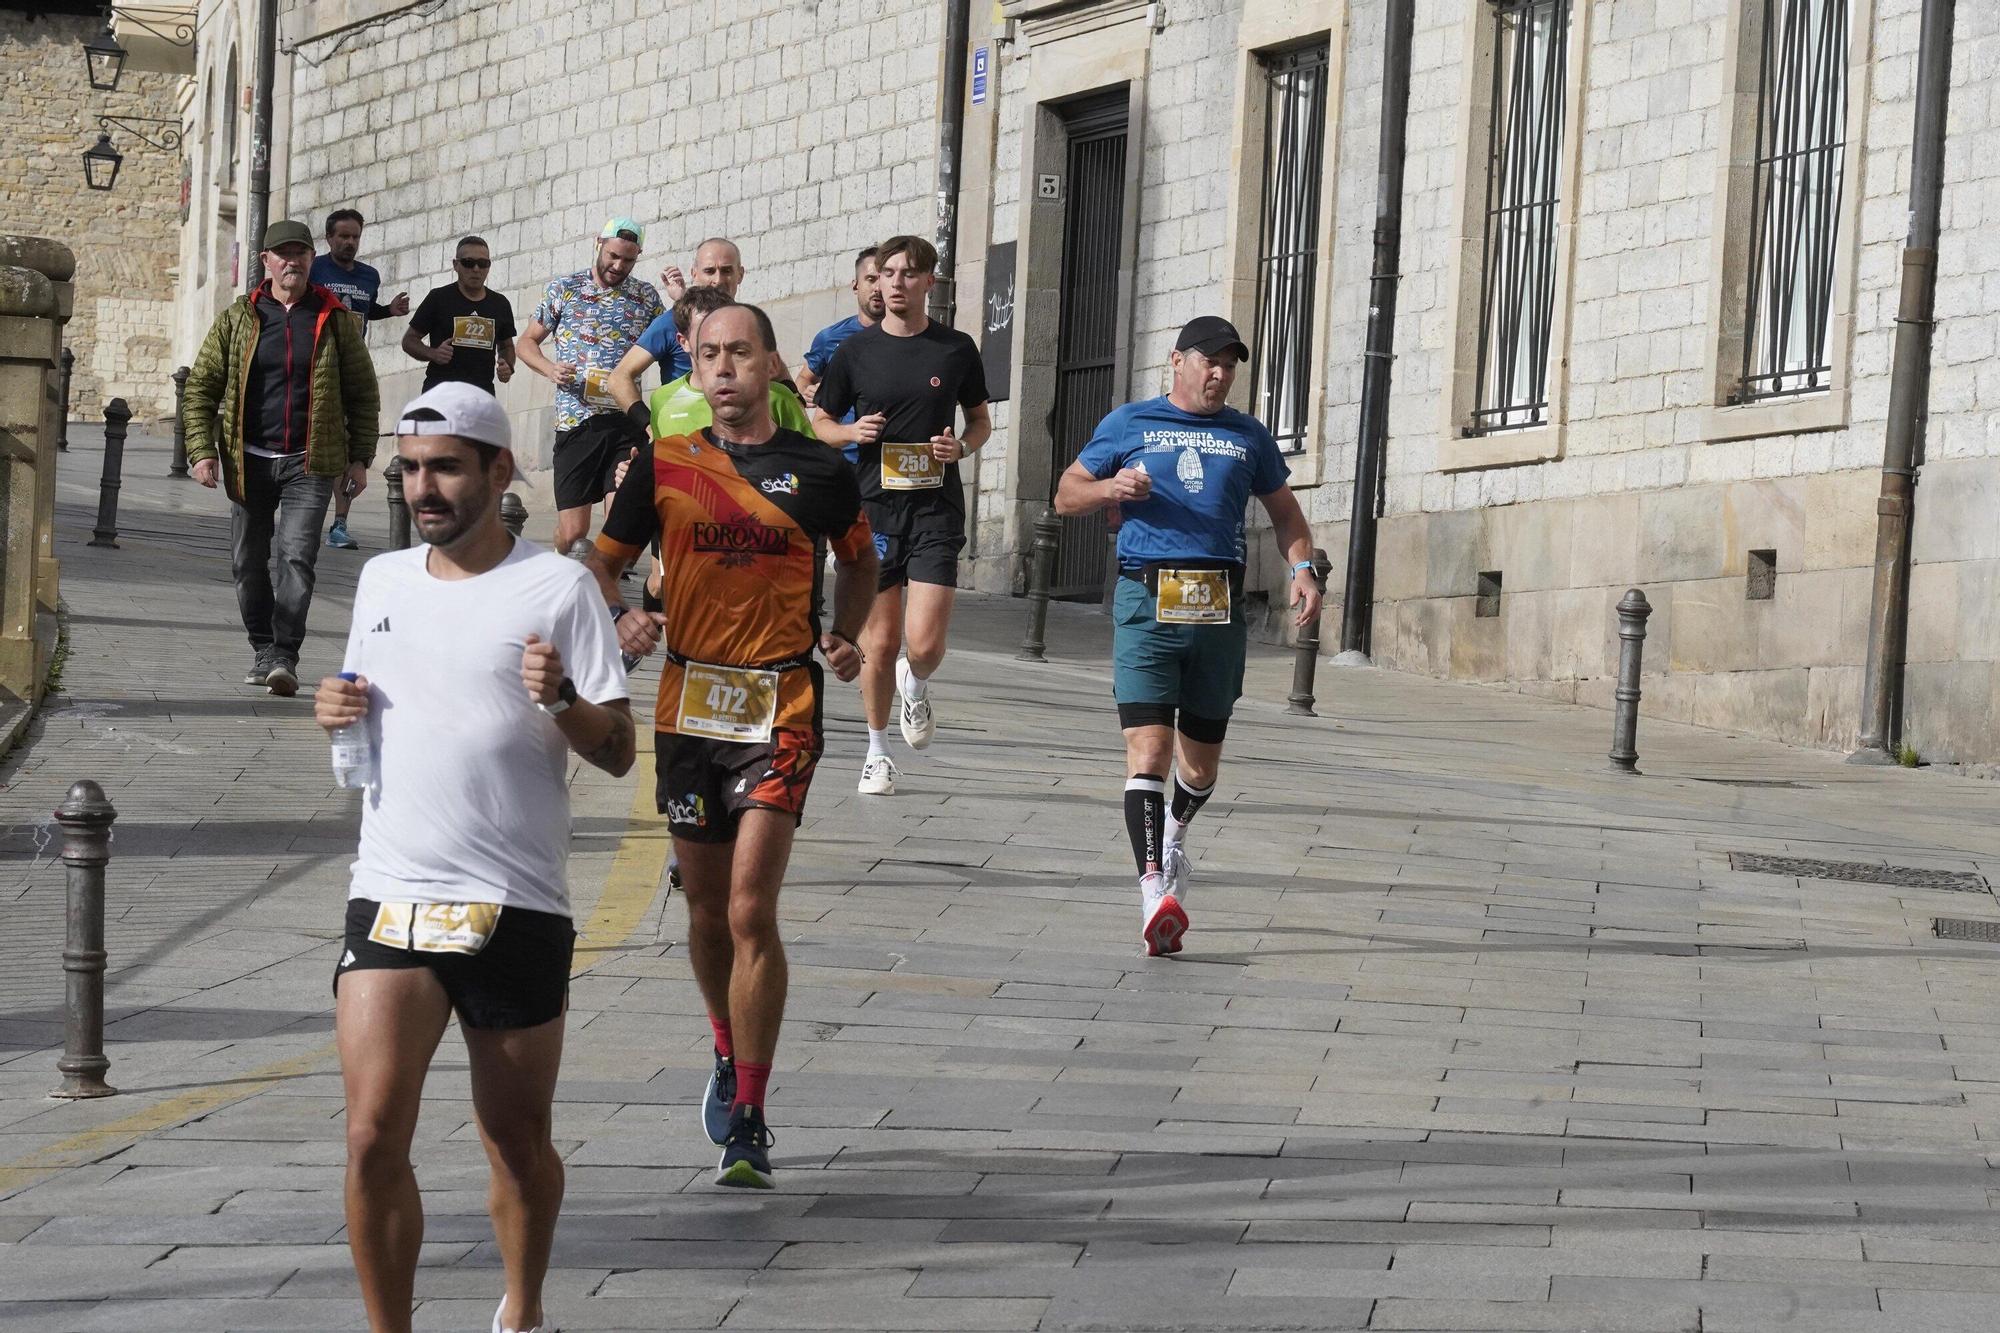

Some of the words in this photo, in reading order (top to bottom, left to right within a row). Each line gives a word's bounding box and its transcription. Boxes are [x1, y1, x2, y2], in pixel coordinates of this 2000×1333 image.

[465, 323, 485, 337] 222
[1157, 431, 1214, 440] CONQUISTA
[1160, 438, 1234, 449] ALMENDRA
[1201, 447, 1246, 461] KONKISTA
[898, 455, 929, 472] 258
[693, 522, 790, 549] FORONDA
[1179, 584, 1211, 604] 133
[706, 685, 748, 714] 472
